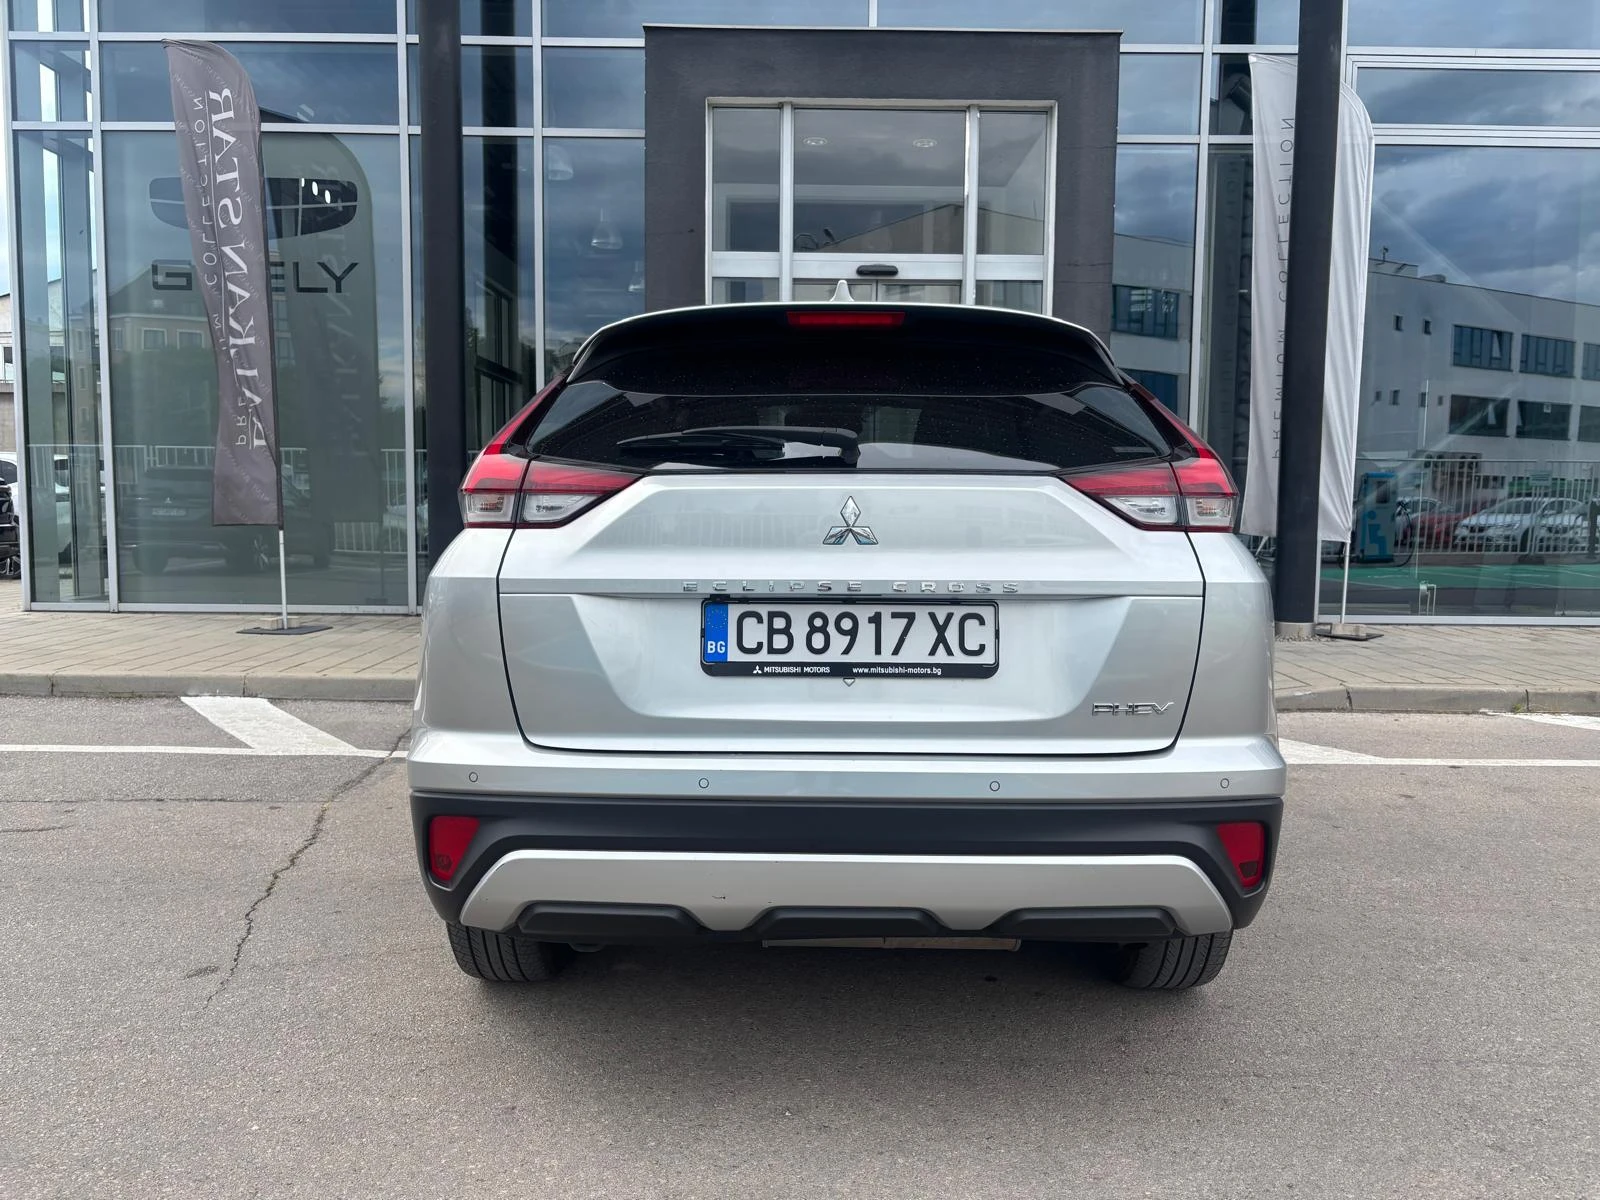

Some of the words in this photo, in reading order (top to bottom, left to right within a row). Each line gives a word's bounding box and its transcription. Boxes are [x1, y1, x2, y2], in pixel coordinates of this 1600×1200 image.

[151, 260, 359, 294] GLY
[683, 581, 862, 592] ECLIPSE
[892, 581, 1019, 593] CROSS
[735, 610, 795, 656] CB
[805, 610, 917, 657] 8917
[927, 611, 986, 658] XC
[707, 641, 726, 654] BG
[852, 666, 942, 676] www.mitsubishi-motors.bg
[1092, 701, 1175, 716] PHEV
